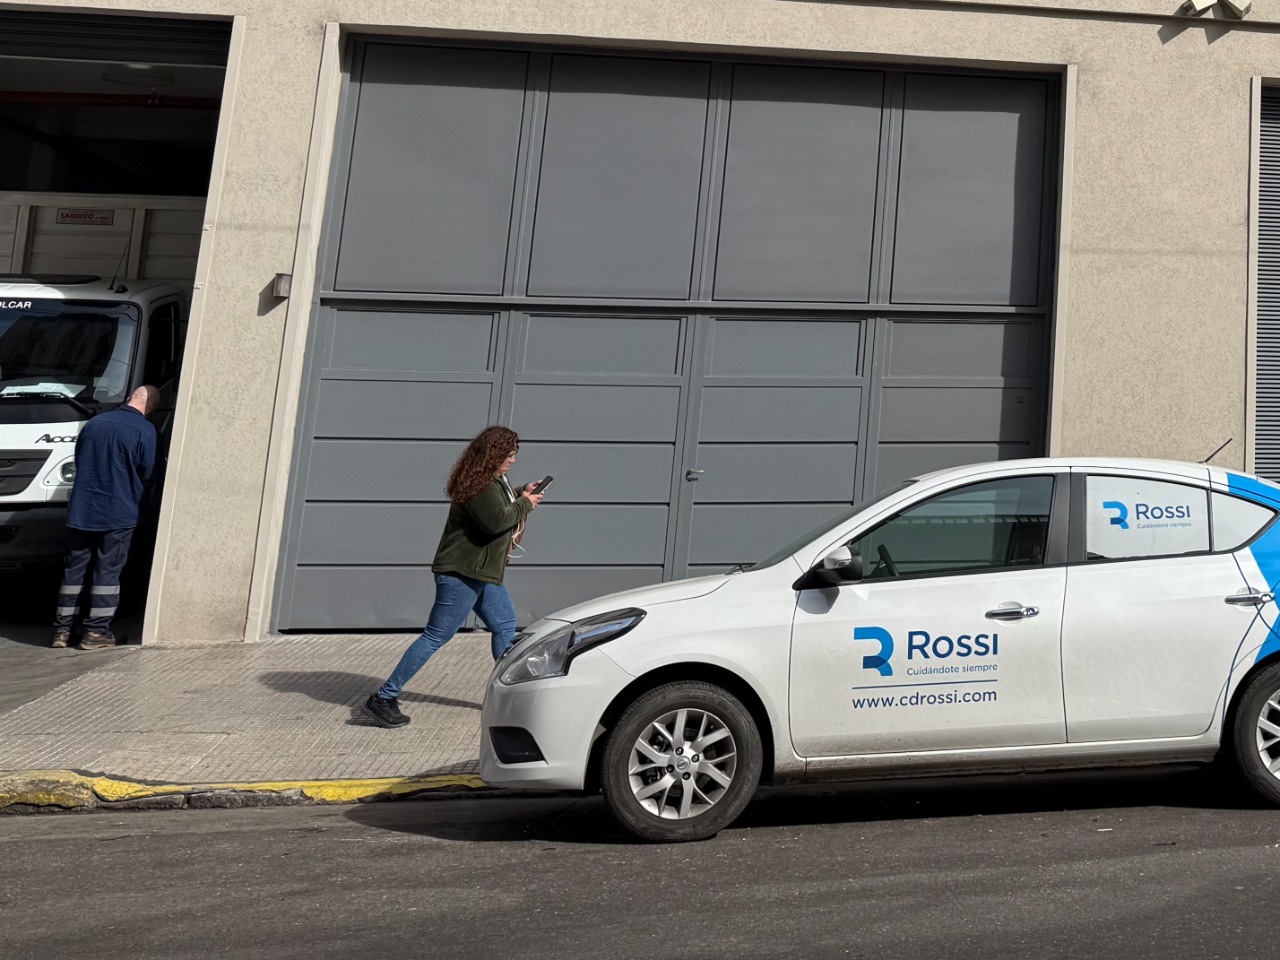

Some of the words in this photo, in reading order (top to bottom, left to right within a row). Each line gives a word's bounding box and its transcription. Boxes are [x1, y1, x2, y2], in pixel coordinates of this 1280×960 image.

[0, 300, 32, 309] LCAR
[906, 665, 960, 676] Cuidándote
[961, 663, 998, 674] siempre
[852, 689, 998, 709] www.cdrossi.com
